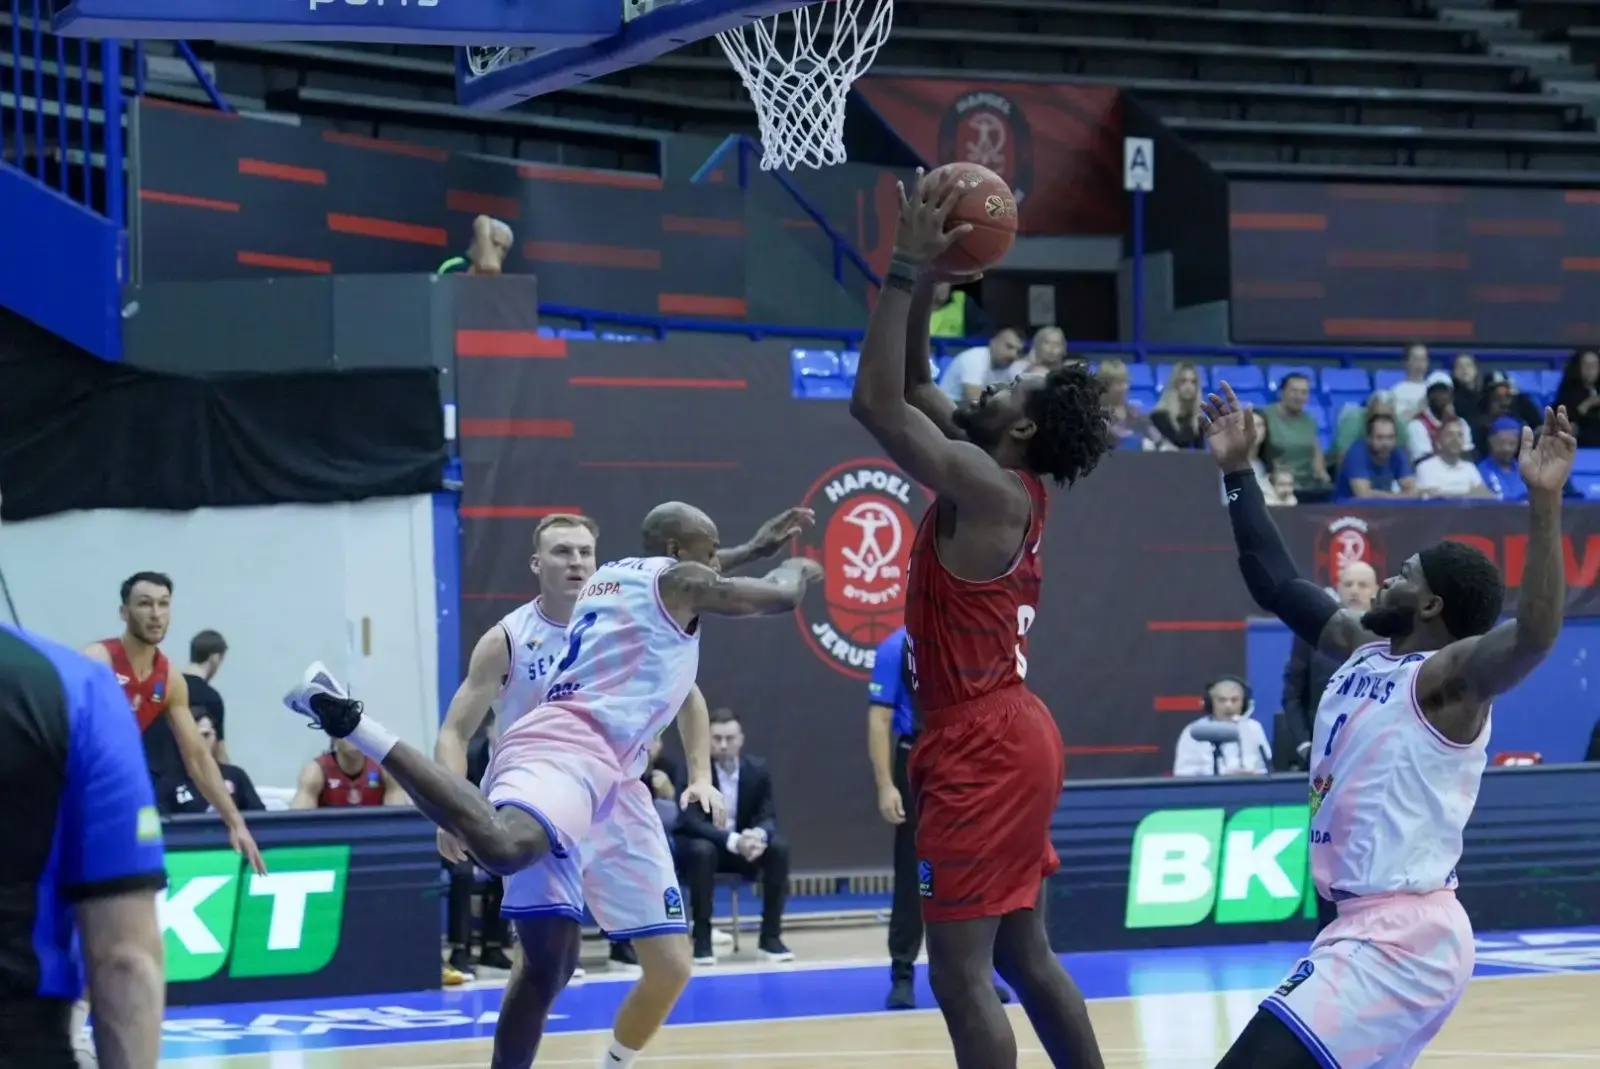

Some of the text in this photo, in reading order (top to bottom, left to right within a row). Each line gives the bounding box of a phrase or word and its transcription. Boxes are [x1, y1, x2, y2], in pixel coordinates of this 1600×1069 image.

[1131, 145, 1149, 172] A
[824, 469, 911, 504] HAPOEL
[812, 622, 878, 669] JERUS
[1136, 828, 1304, 905] BK
[155, 870, 336, 955] KT
